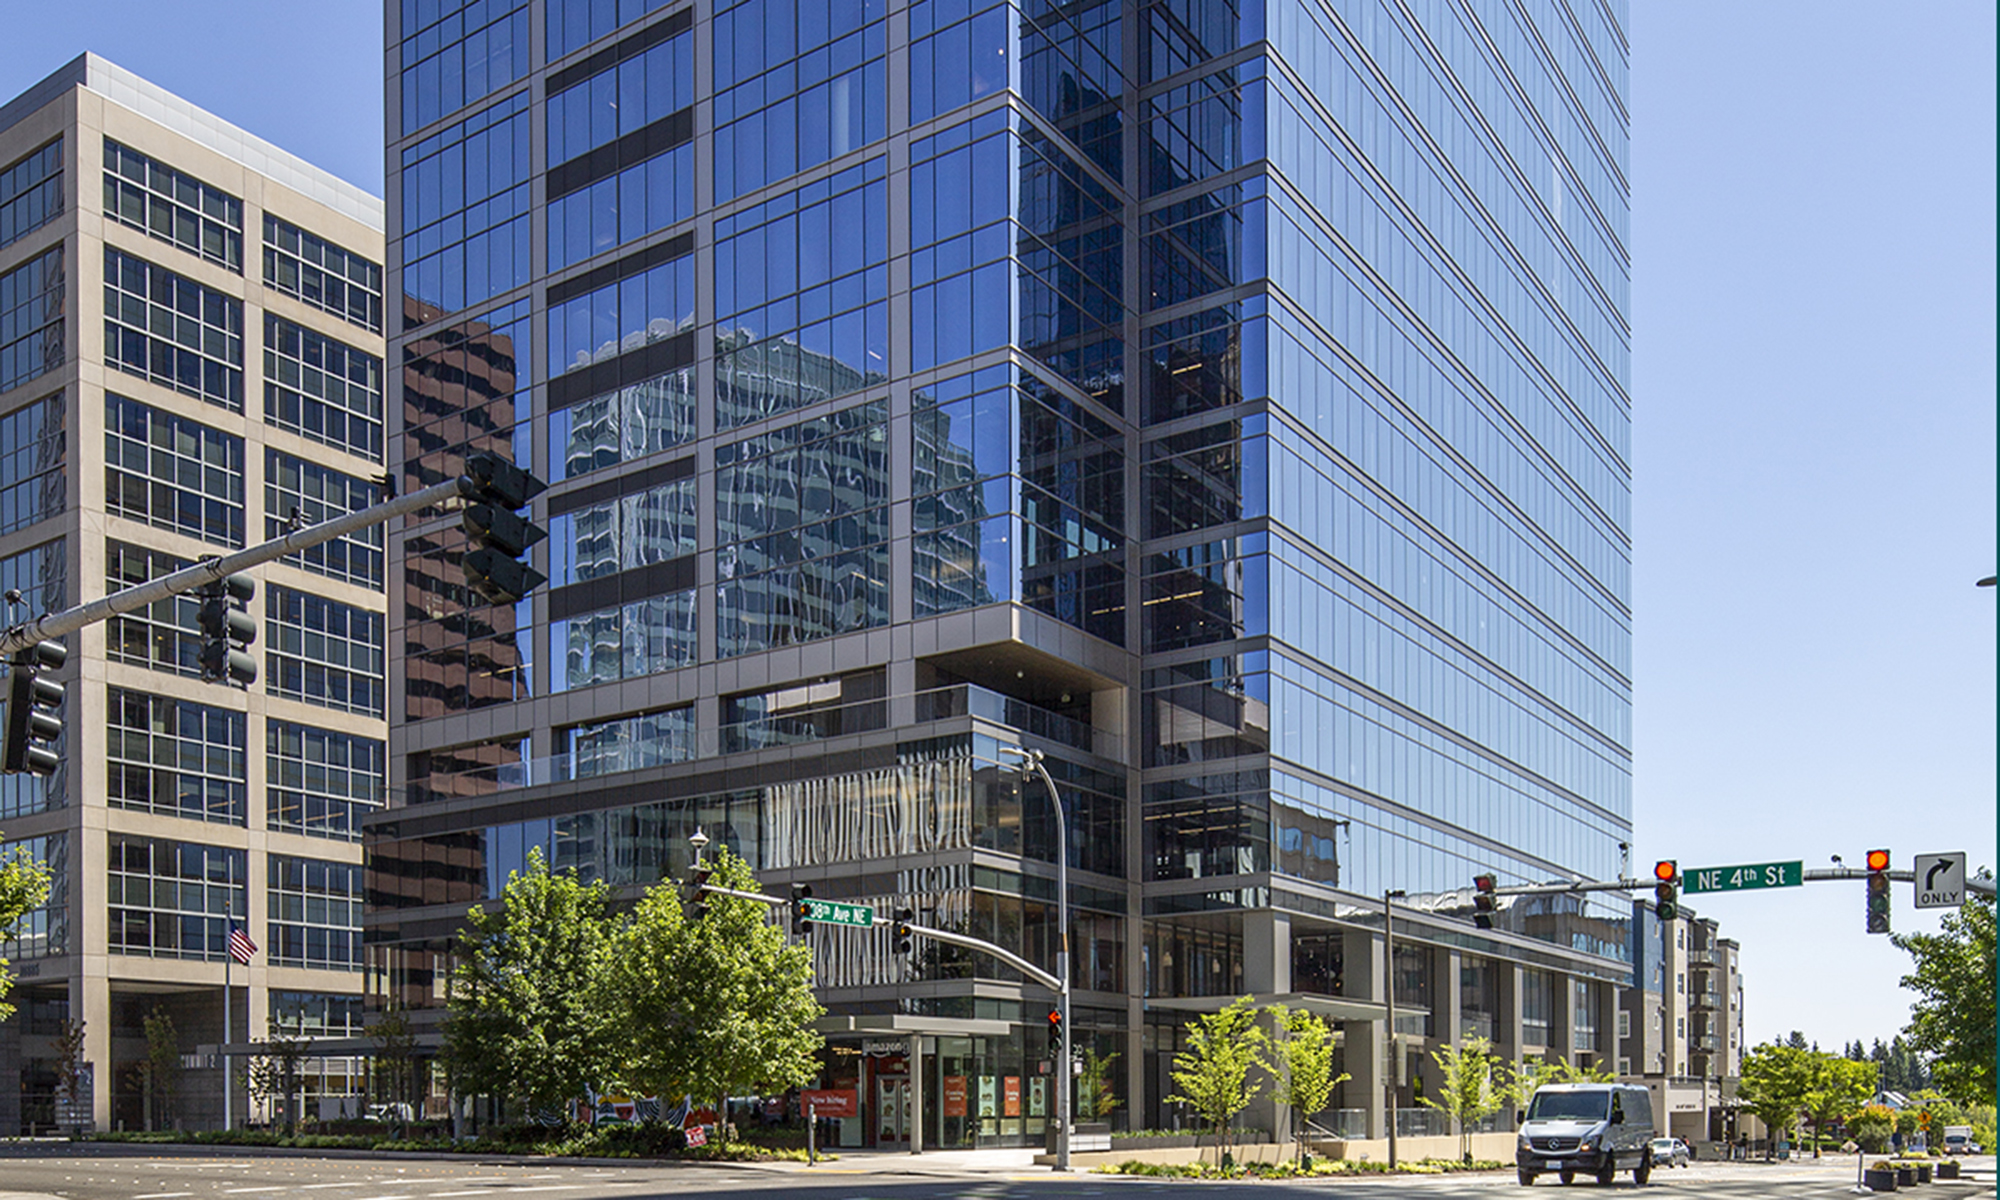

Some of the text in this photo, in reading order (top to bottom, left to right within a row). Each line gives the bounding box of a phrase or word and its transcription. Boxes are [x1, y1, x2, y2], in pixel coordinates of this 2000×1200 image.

[1698, 866, 1785, 890] NE 4th St
[1921, 891, 1959, 904] ONLY
[809, 902, 866, 924] 08th Ave NE
[866, 1042, 902, 1054] amazon
